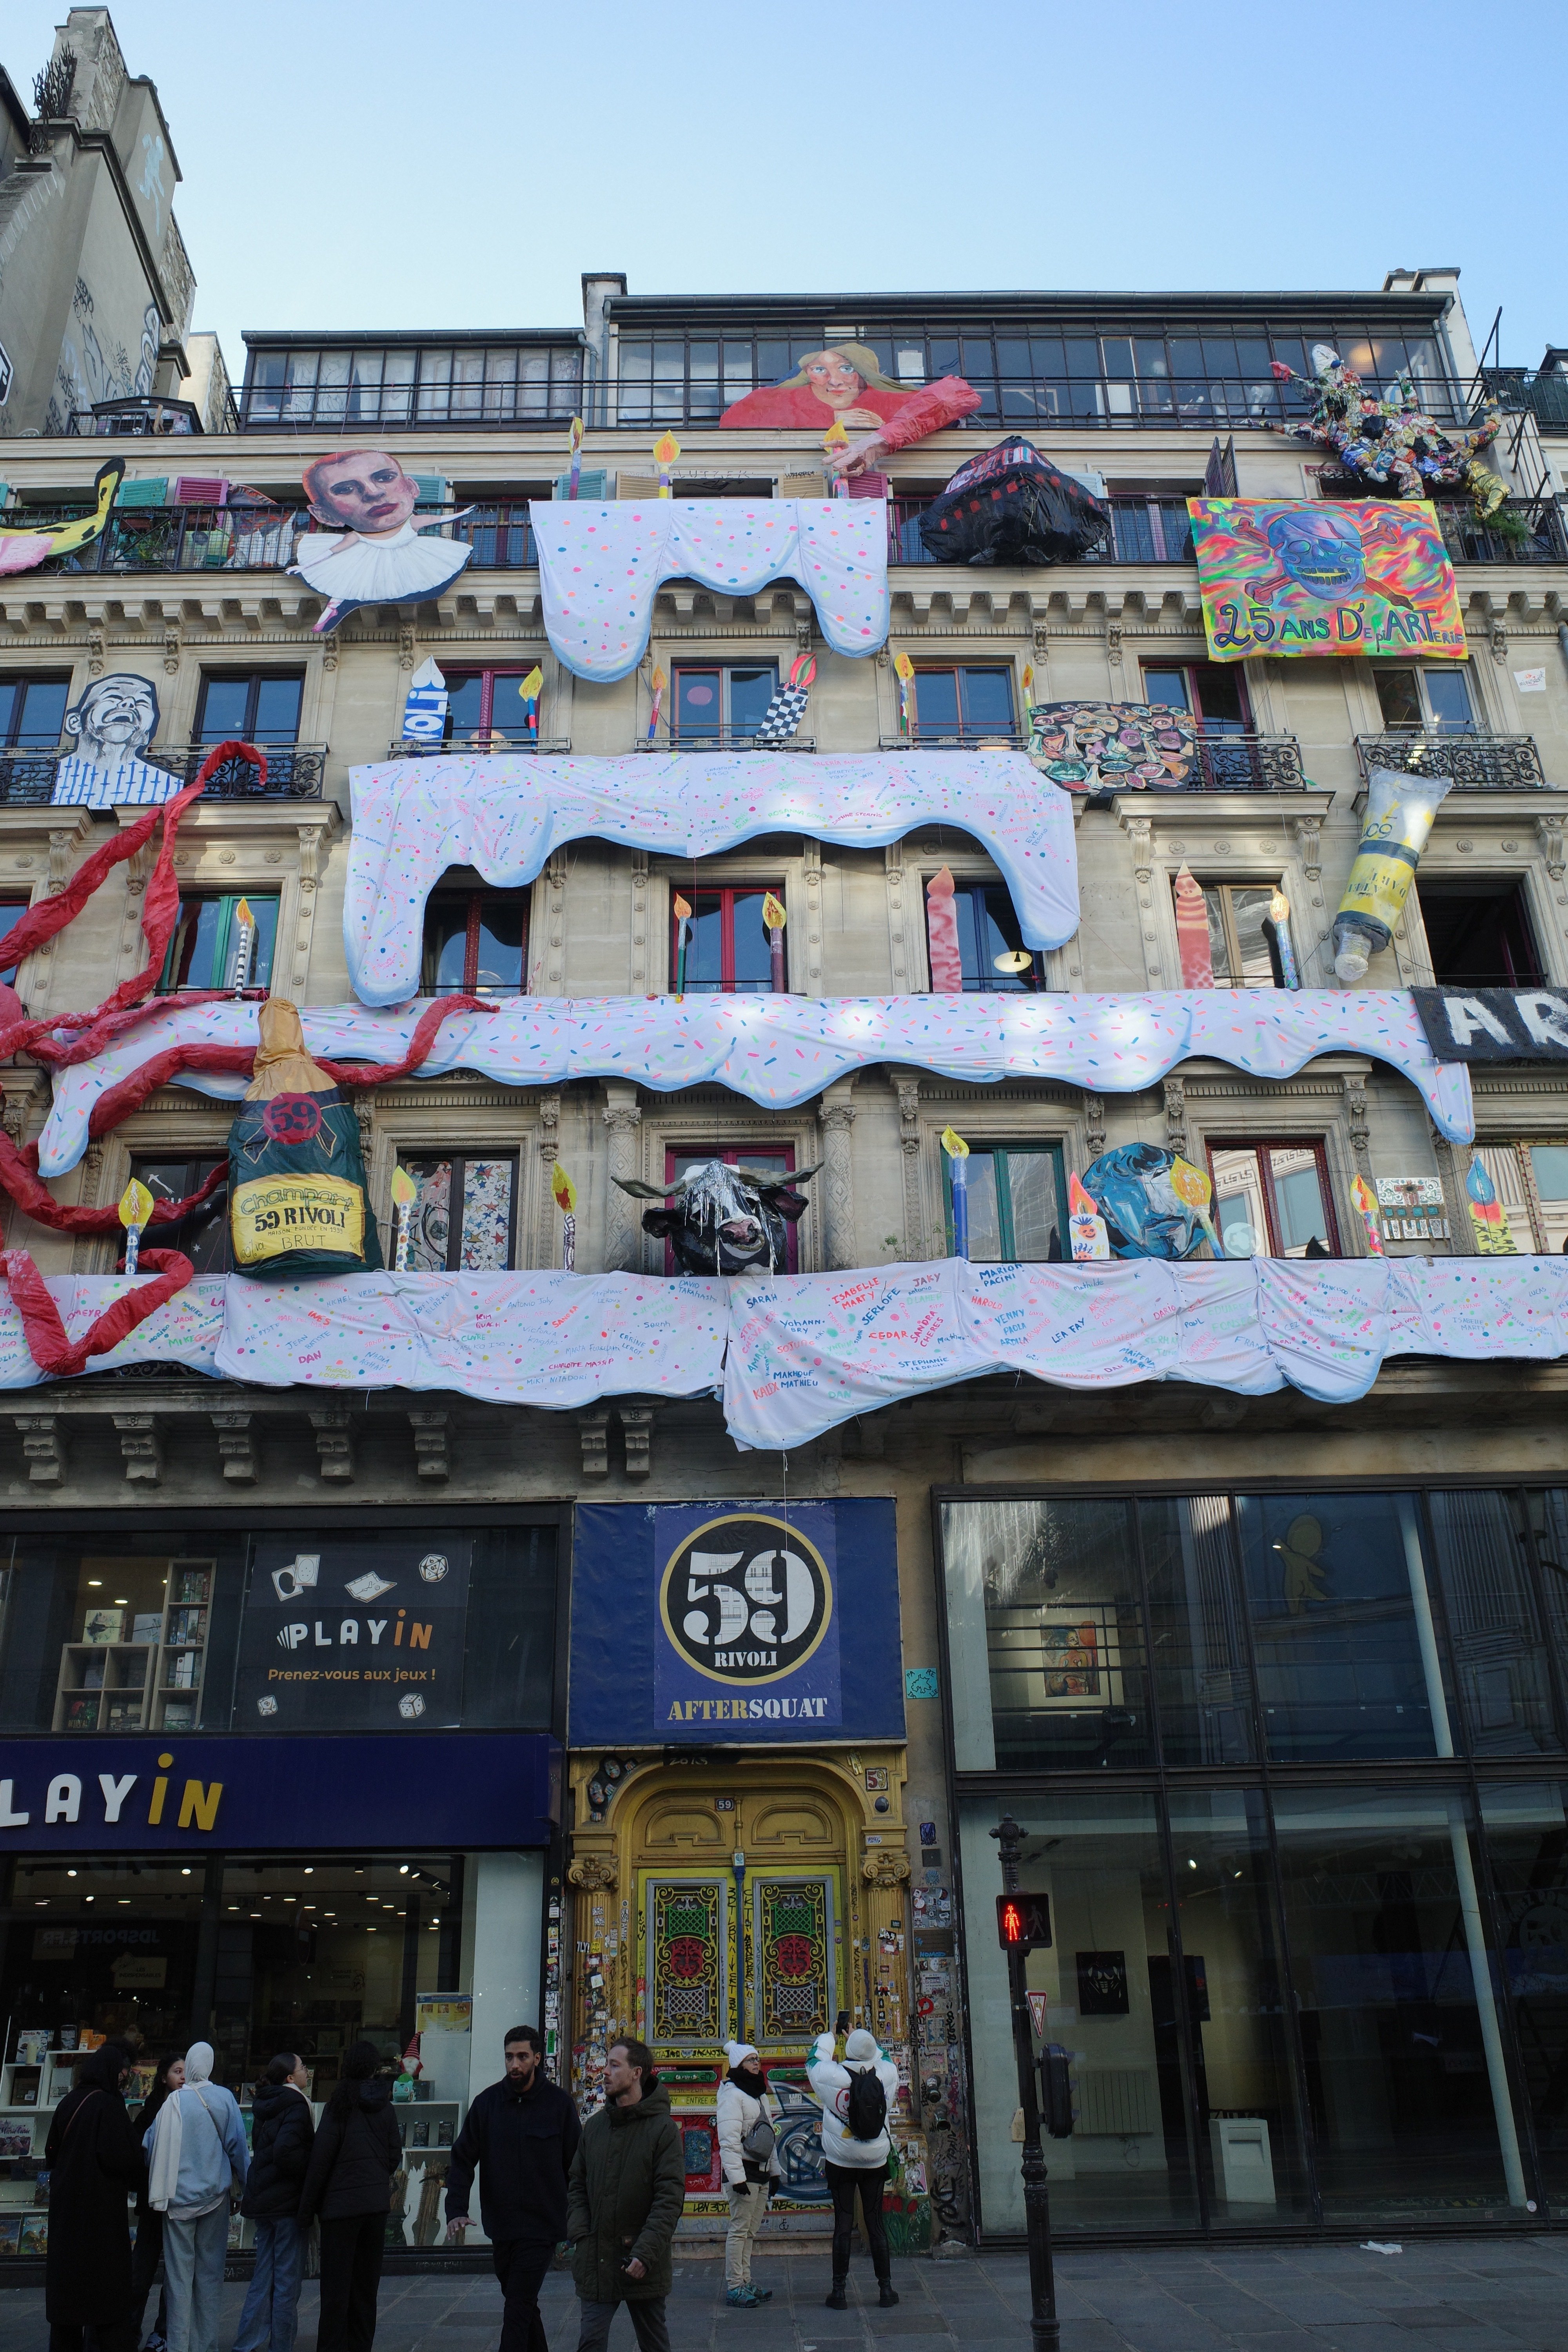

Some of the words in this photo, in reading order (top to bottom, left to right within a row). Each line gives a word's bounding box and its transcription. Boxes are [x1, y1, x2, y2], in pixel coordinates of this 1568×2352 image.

[1215, 604, 1274, 648] 25
[1280, 619, 1330, 639] ANS
[832, 812, 853, 825] DAPHNE
[1025, 829, 1039, 844] EVE
[271, 1101, 317, 1133] 59
[255, 1210, 279, 1232] 59
[284, 1207, 345, 1228] RIVOLI
[256, 1241, 266, 1251] VOL
[282, 1234, 326, 1249] BRUT
[913, 1273, 941, 1287] JAKY
[1550, 1270, 1562, 1279] BAR
[679, 1280, 700, 1289] DAVID
[831, 1277, 881, 1304] ISABELLE
[1073, 1278, 1104, 1291] Mathilde
[1501, 1276, 1517, 1291] MOMO
[358, 1288, 376, 1297] VRAY
[1529, 1286, 1546, 1297] LUCAS
[746, 1294, 778, 1309] SARAH
[842, 1290, 875, 1310] MARTY
[971, 1296, 1003, 1310] HAROLD
[1089, 1287, 1113, 1314] ARTHUR
[552, 1305, 579, 1328] SANDRA
[1442, 1307, 1456, 1316] PAUL
[740, 1316, 761, 1341] STAN
[910, 1310, 938, 1343] SANDRA
[1003, 1322, 1027, 1336] PAOLA
[1051, 1330, 1068, 1343] LEA
[1068, 1317, 1085, 1333] FAY
[1102, 1318, 1116, 1327] LEA
[1285, 1321, 1300, 1331] CEZ
[365, 1337, 385, 1348] SANDY
[389, 1331, 410, 1340] BELLE
[869, 1330, 909, 1341] CEDAR
[920, 1317, 944, 1347] CHERES
[1299, 1330, 1319, 1343] Axel
[285, 1334, 309, 1350] JEAN
[622, 1343, 642, 1356] LEROY
[298, 1350, 321, 1364] DAN
[747, 1339, 774, 1373] AMADOU
[548, 1361, 583, 1370] CHARLOTTE
[828, 1390, 852, 1399] DAN
[684, 1550, 815, 1644] 59
[714, 1651, 778, 1667] RIVOLI
[269, 1668, 359, 1681] Prenez-vous
[363, 1671, 391, 1681] aux
[393, 1668, 427, 1682] jeux
[431, 1668, 436, 1680] !
[667, 1698, 828, 1720] AFTERSQUAT
[867, 1769, 886, 1789] 59
[718, 1800, 731, 1809] 59
